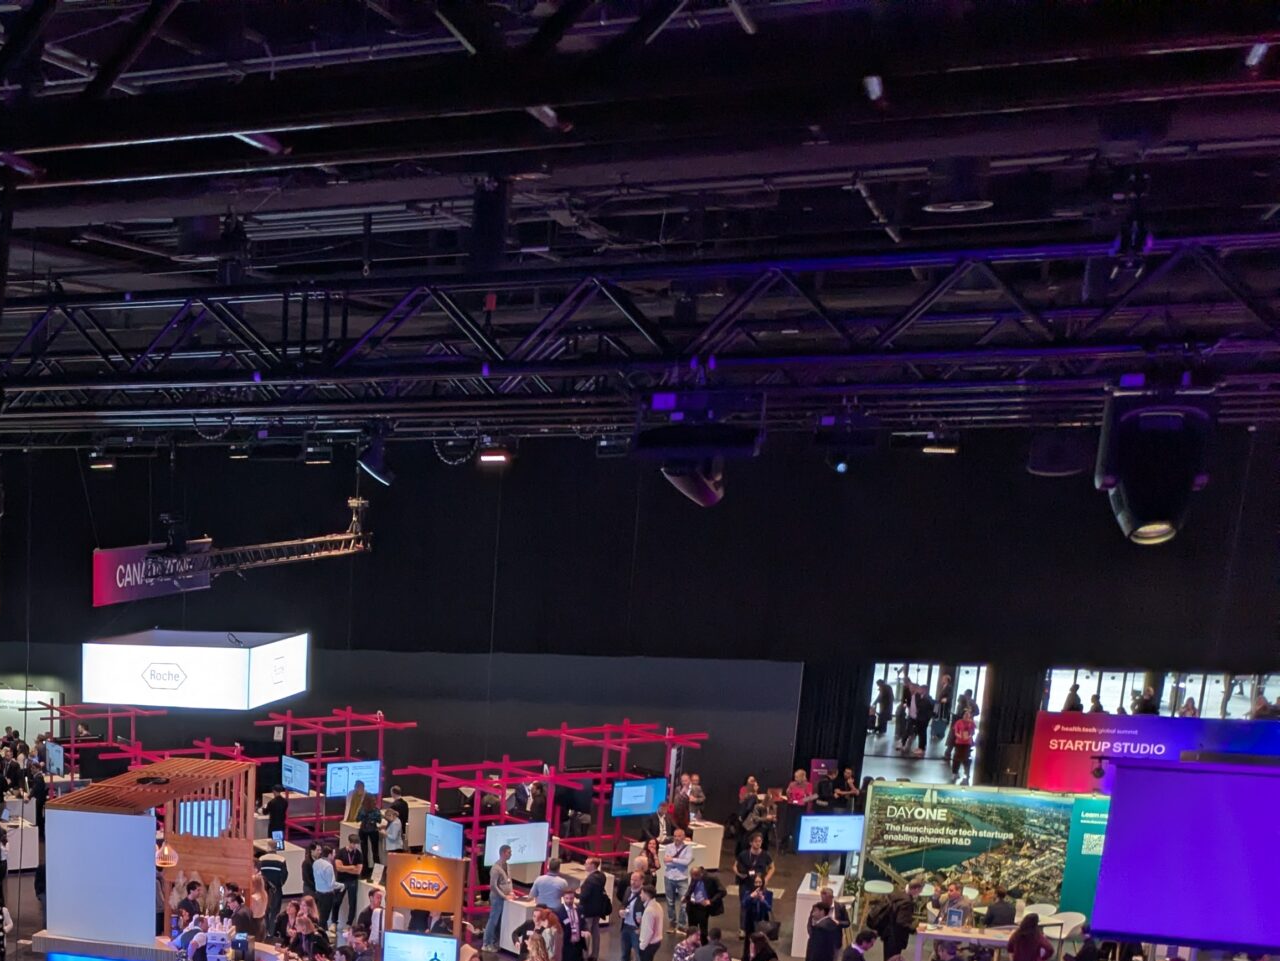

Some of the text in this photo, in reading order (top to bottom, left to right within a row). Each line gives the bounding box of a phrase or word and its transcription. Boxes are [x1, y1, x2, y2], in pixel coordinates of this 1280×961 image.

[150, 669, 180, 682] Roche
[1049, 739, 1165, 755] STARTUP STUDIO
[886, 805, 948, 821] DAYONE
[885, 823, 1014, 840] The launchpad for tech startups
[884, 833, 971, 846] enabling pharma R&D
[409, 877, 440, 892] Roche
